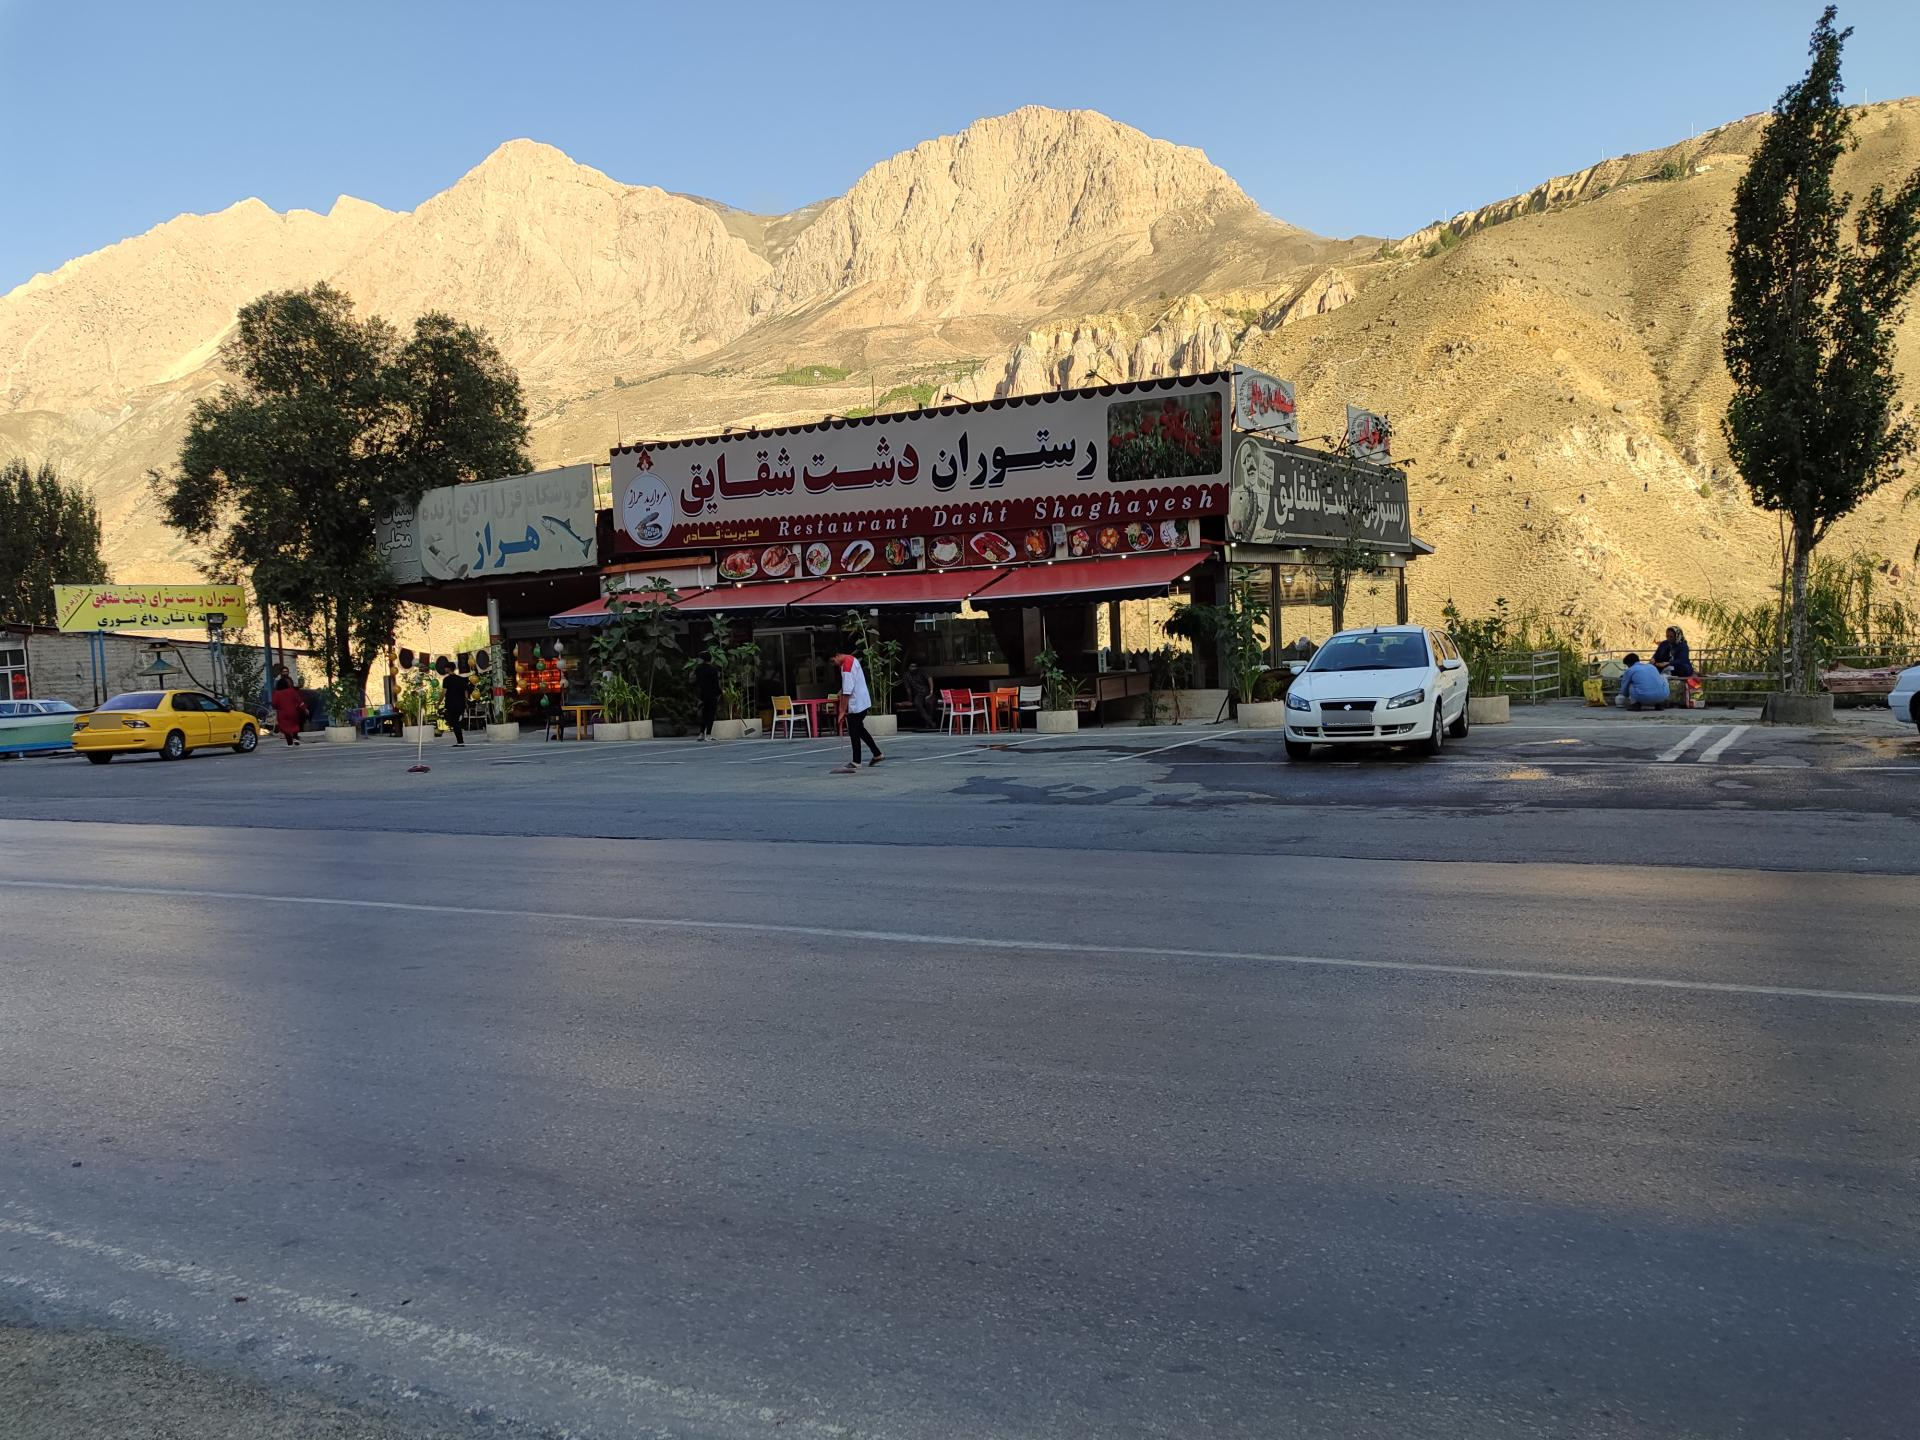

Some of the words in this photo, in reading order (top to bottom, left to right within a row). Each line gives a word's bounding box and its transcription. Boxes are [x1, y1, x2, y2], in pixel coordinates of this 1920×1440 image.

[802, 436, 920, 494] دشت
[930, 429, 1098, 491] رستوران
[527, 474, 589, 510] فروشگاه
[680, 447, 796, 517] شقایق
[422, 496, 454, 526] زنده
[457, 488, 488, 523] آلای
[494, 485, 523, 520] قزل
[628, 488, 643, 509] هراز
[643, 488, 667, 511] مروارید
[1274, 470, 1321, 526] شقایق
[1362, 484, 1406, 536] رستوران
[778, 513, 909, 537] Restaurant
[933, 505, 1008, 528] Dasht
[1034, 490, 1214, 521] Shaghayesh
[379, 527, 413, 557] محلی
[472, 521, 541, 571] هراز
[92, 592, 120, 609] شقایق
[123, 592, 146, 604] دشت
[151, 591, 174, 608] سرای
[176, 594, 196, 605] سنت
[199, 597, 204, 608] و
[206, 592, 241, 608] رستوران
[97, 614, 137, 627] تنوری
[140, 612, 158, 627] داغ
[162, 611, 185, 625] نان
[188, 612, 196, 624] با
